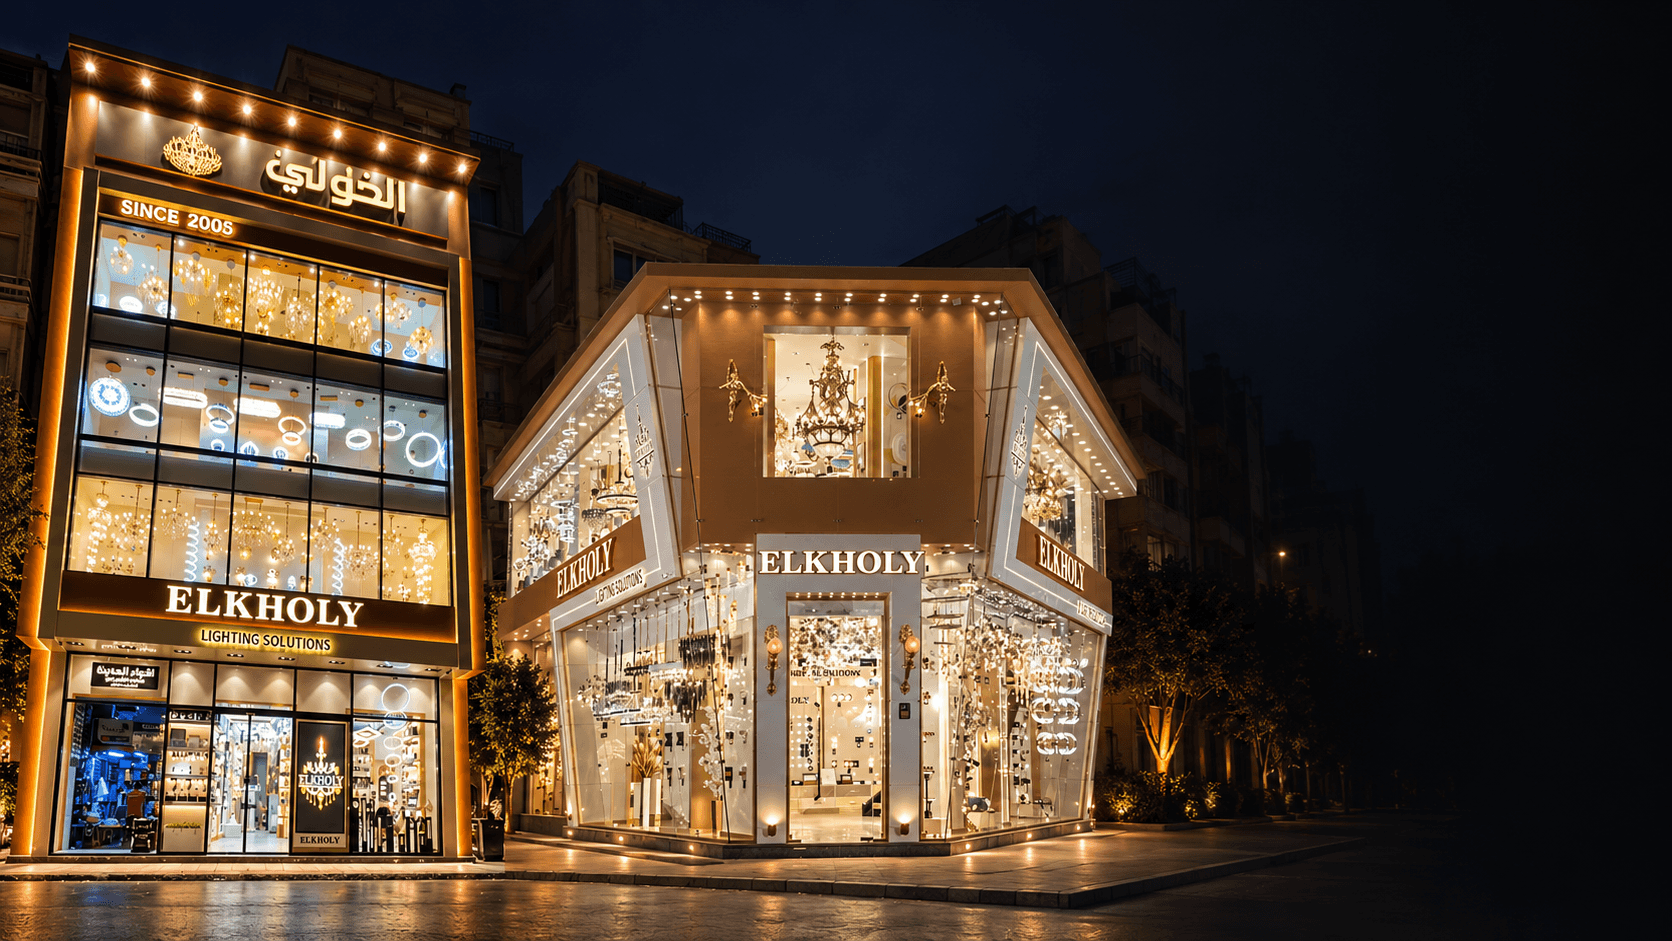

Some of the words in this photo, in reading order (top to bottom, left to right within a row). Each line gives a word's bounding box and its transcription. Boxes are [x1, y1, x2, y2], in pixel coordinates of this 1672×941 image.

[265, 149, 406, 214] الخولي
[120, 199, 180, 227] SINCE
[187, 212, 235, 237] 2005
[556, 536, 615, 599] ELKHOLY
[758, 549, 925, 575] ELKHOLY
[1038, 533, 1086, 591] ELKHOLY
[165, 584, 364, 628] ELKHOLY
[200, 629, 261, 648] LIGHTING
[263, 634, 332, 652] SOLUTIONS
[300, 836, 341, 845] ELKHOLY
